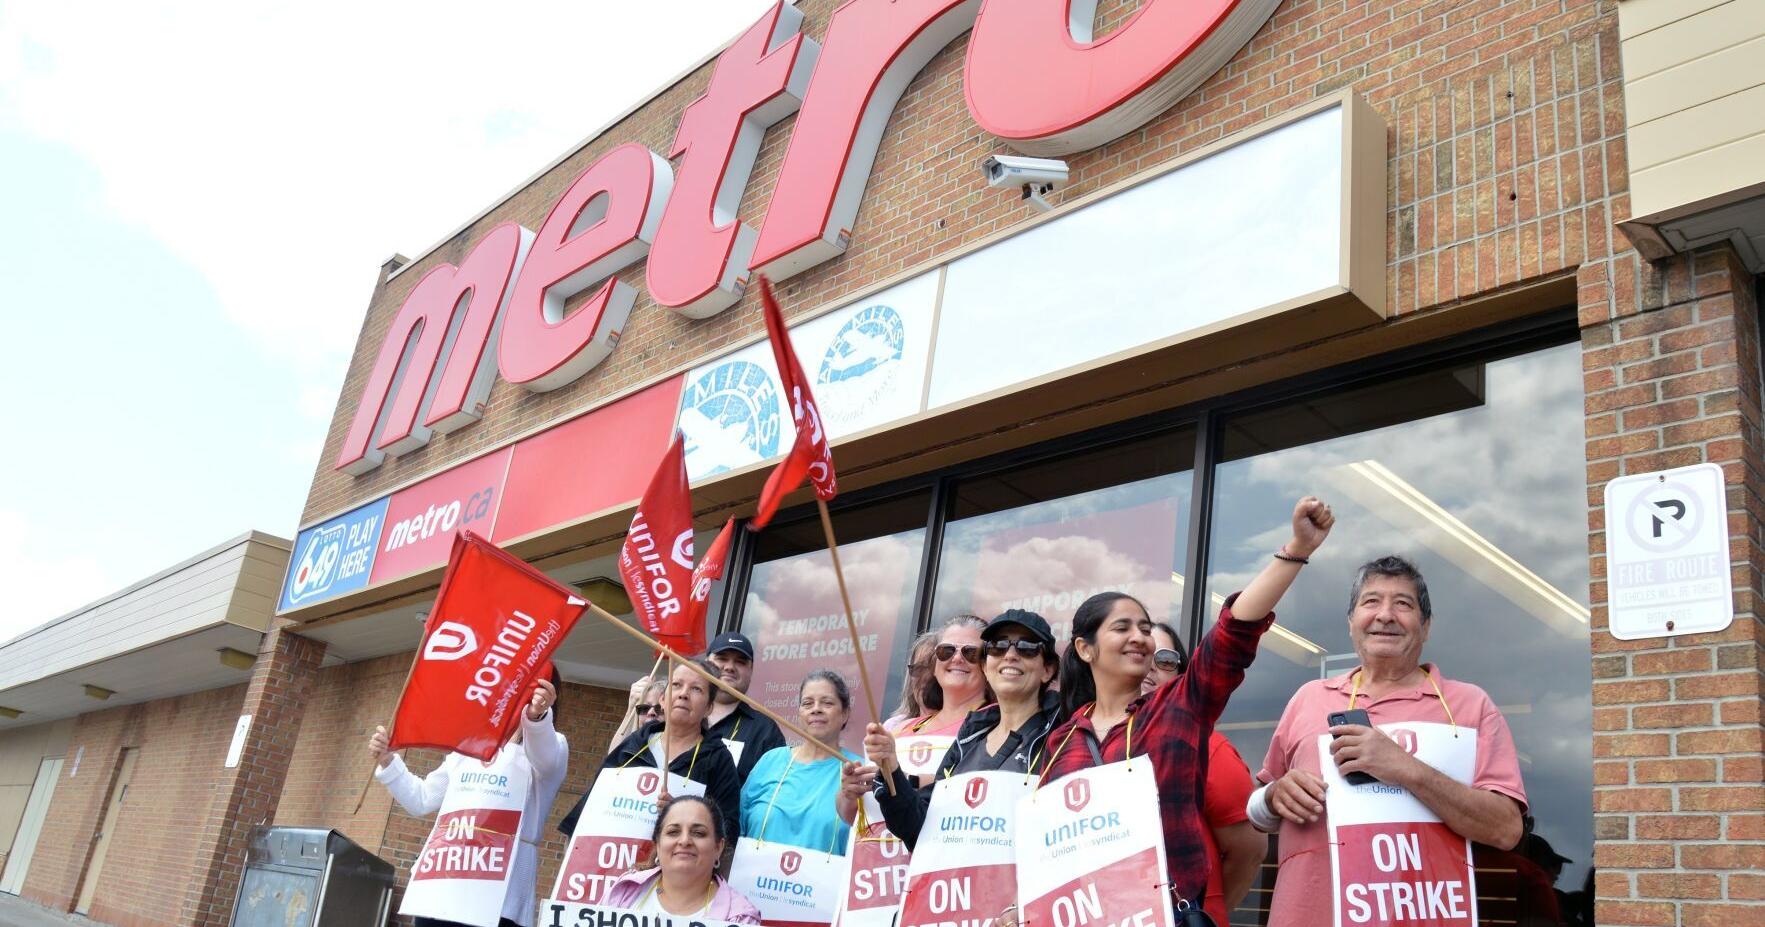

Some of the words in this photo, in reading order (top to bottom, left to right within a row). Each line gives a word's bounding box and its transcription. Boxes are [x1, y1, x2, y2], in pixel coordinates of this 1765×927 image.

[852, 307, 902, 348] MILES
[694, 361, 778, 446] MILES
[346, 515, 379, 551] PLAY
[385, 486, 494, 553] metro.ca
[319, 530, 341, 545] LOTTO
[337, 545, 371, 581] HERE
[1618, 562, 1654, 586] FIRE
[1666, 555, 1718, 580] ROUTE
[777, 608, 870, 636] TEMPORARY
[762, 641, 808, 662] STORE
[811, 634, 879, 658] CLOSURE
[1356, 785, 1402, 795] theUnion
[612, 796, 659, 815] UNIFO
[445, 815, 476, 841] ON
[1083, 829, 1131, 848] syndicat
[598, 842, 638, 870] ON
[879, 829, 911, 858] O
[1371, 833, 1423, 873] ON
[420, 846, 505, 873] STRIKE
[854, 864, 910, 900] STR
[929, 876, 971, 914] ON
[550, 904, 565, 927] I
[1051, 882, 1104, 927] ON
[1345, 880, 1468, 923] STRIKE
